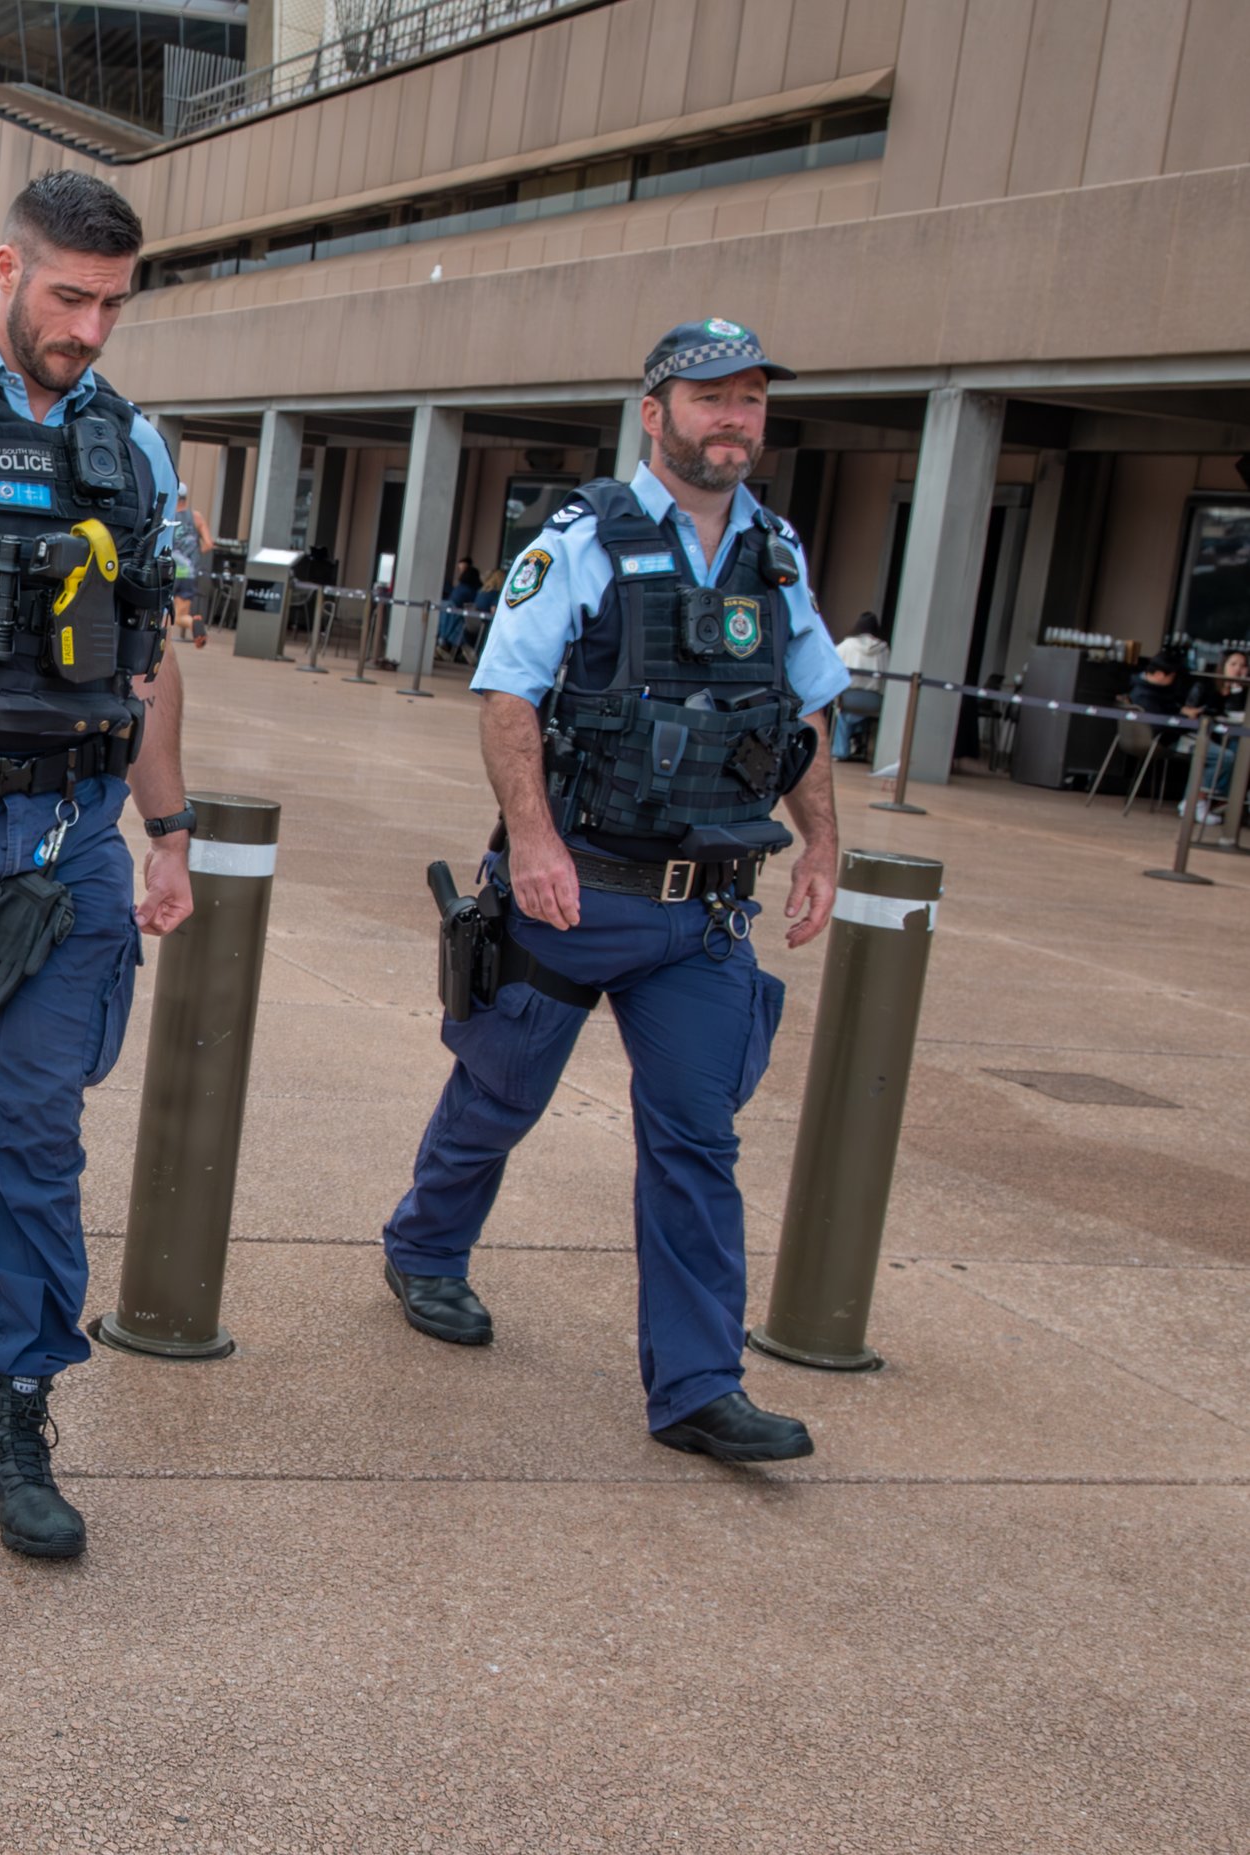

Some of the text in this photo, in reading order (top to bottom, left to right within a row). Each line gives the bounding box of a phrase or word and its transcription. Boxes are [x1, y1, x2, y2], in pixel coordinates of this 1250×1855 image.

[1, 447, 27, 455] SOUTH
[246, 588, 281, 600] midden
[63, 635, 72, 662] TASER
